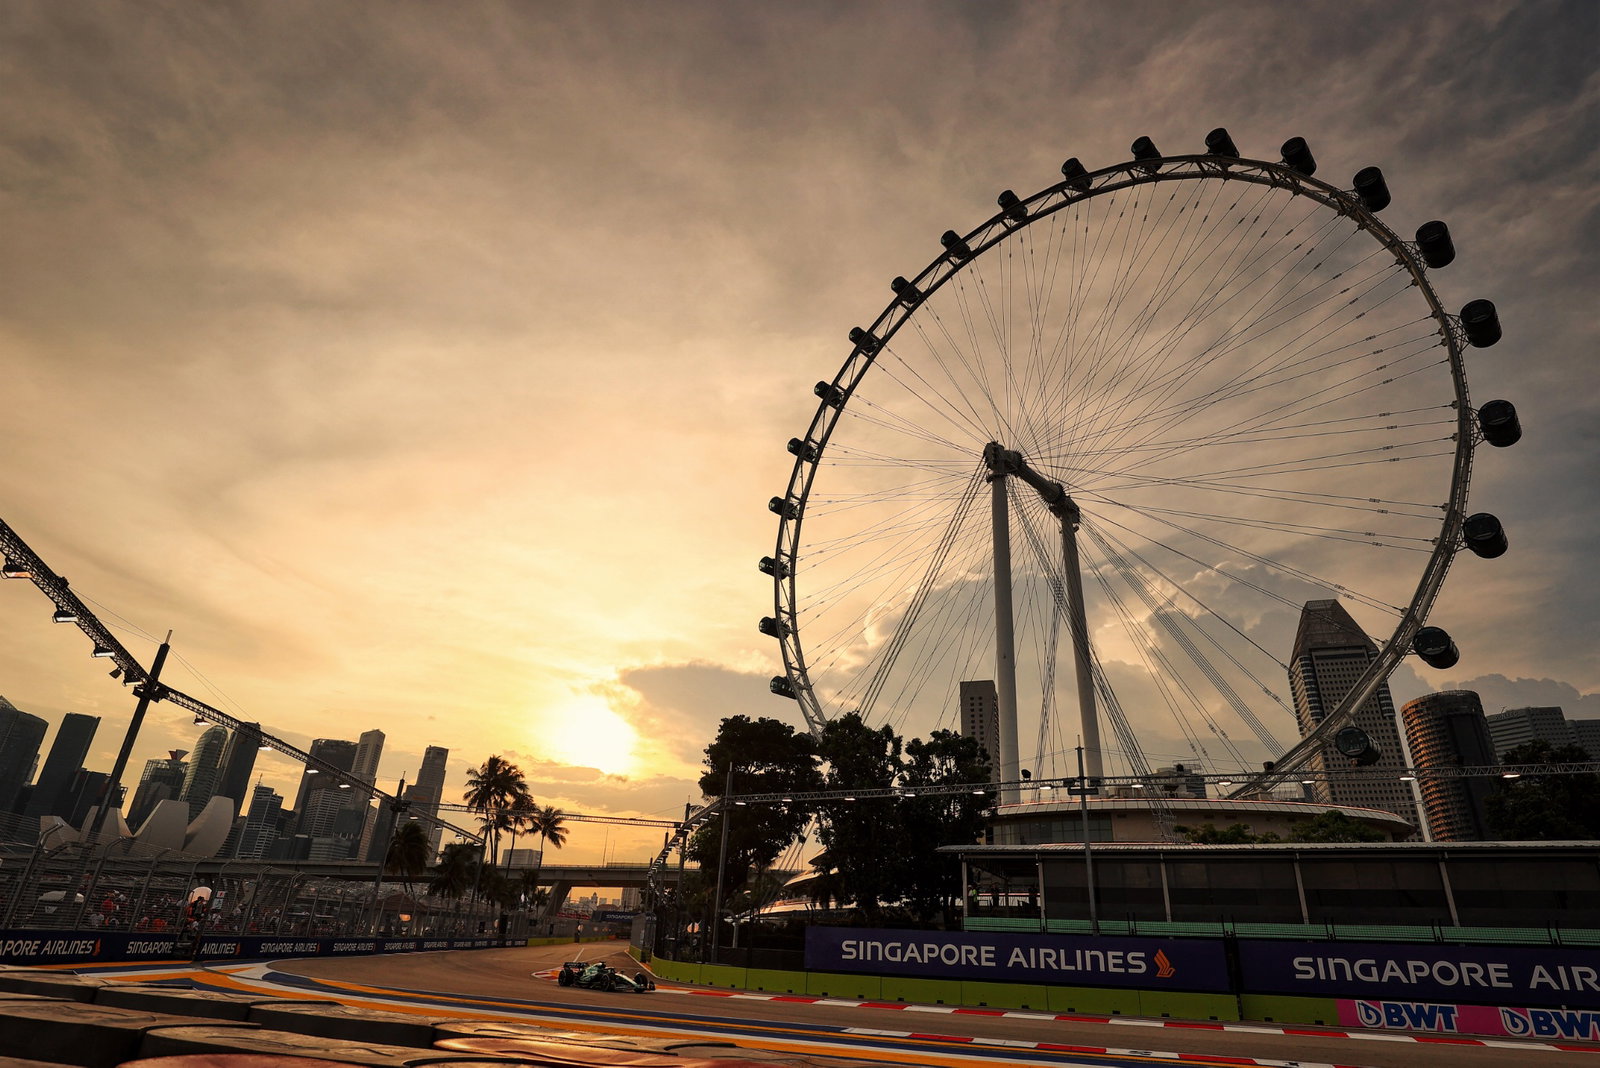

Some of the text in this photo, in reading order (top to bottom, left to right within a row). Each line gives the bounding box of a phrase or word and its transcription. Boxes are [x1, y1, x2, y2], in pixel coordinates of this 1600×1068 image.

[41, 939, 95, 955] AIRLINES
[126, 941, 235, 955] SINGAPORE AIRLINES
[259, 942, 318, 953] SINGAPORE AIRLINES
[841, 939, 1147, 974] SINGAPORE AIRLINES
[1292, 956, 1600, 992] SINGAPORE AIR
[1382, 1001, 1458, 1032] BWT
